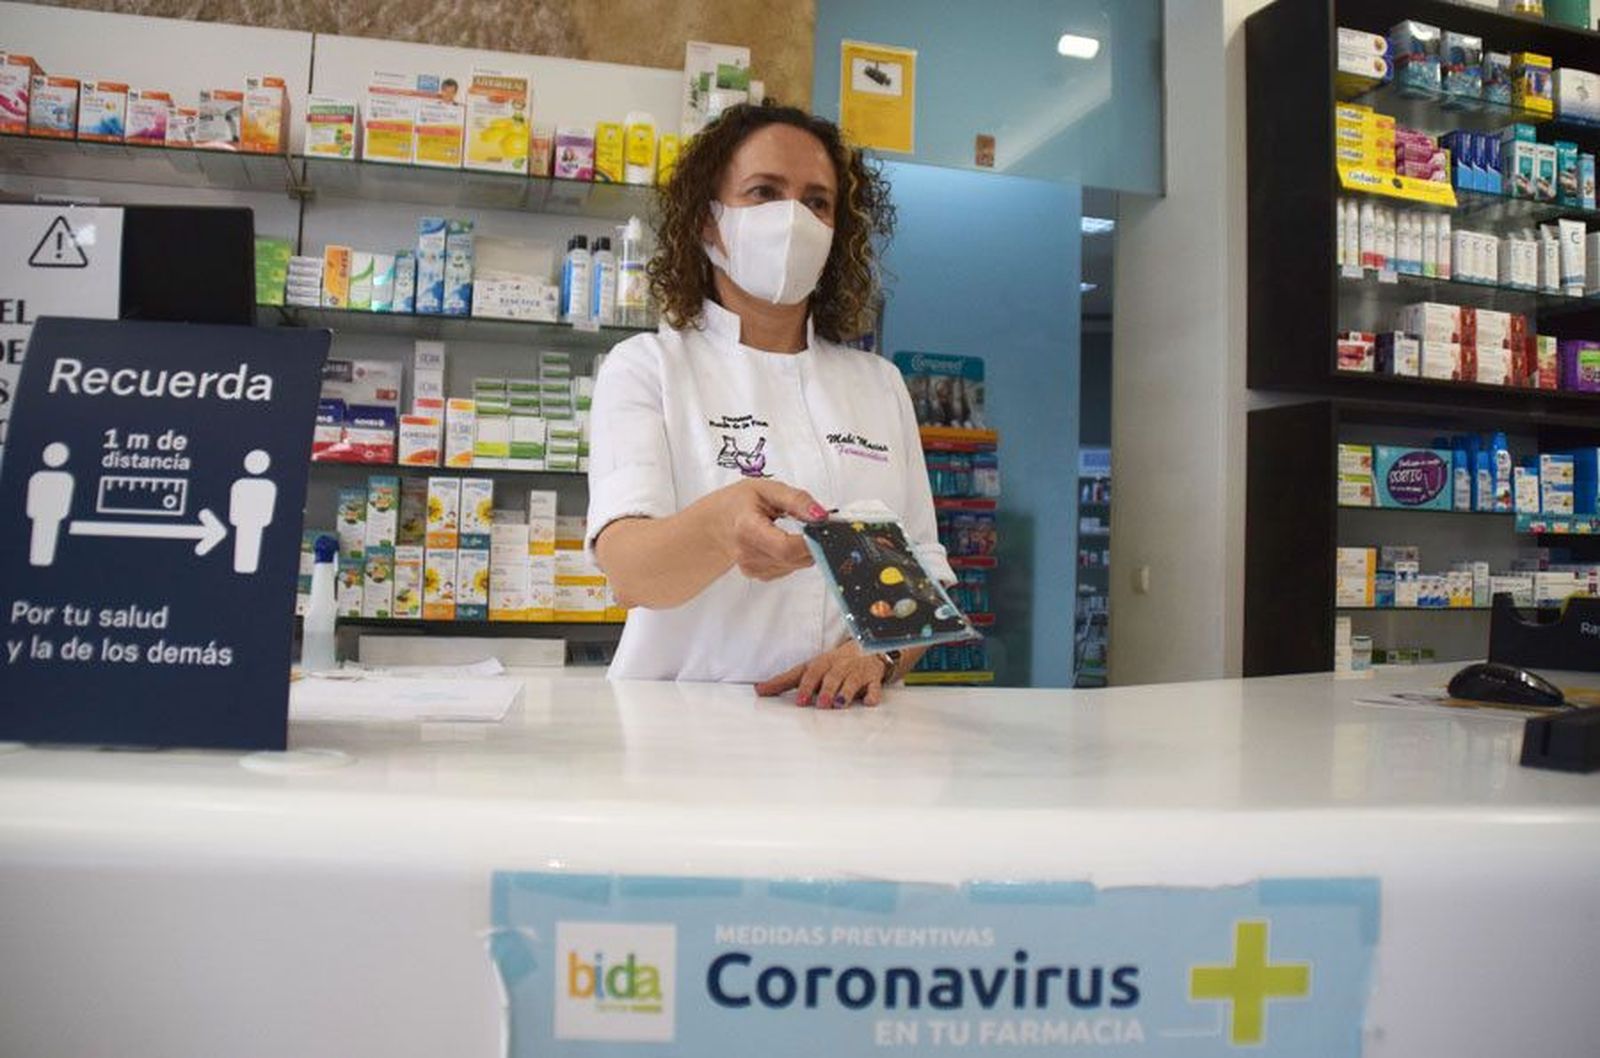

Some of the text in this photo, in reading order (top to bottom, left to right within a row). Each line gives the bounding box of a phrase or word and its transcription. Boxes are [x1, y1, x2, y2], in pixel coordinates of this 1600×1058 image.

[49, 358, 273, 401] Recuerda
[103, 428, 187, 450] 1 m de
[102, 451, 191, 470] distancia
[11, 601, 169, 629] Por tu salud
[7, 636, 234, 666] y la de los demás
[715, 925, 995, 948] MEDIDAS PREVENTIVAS
[568, 953, 662, 999] bida
[706, 949, 1141, 1010] Coronavirus
[874, 1020, 1145, 1046] EN TU FARMACIA
